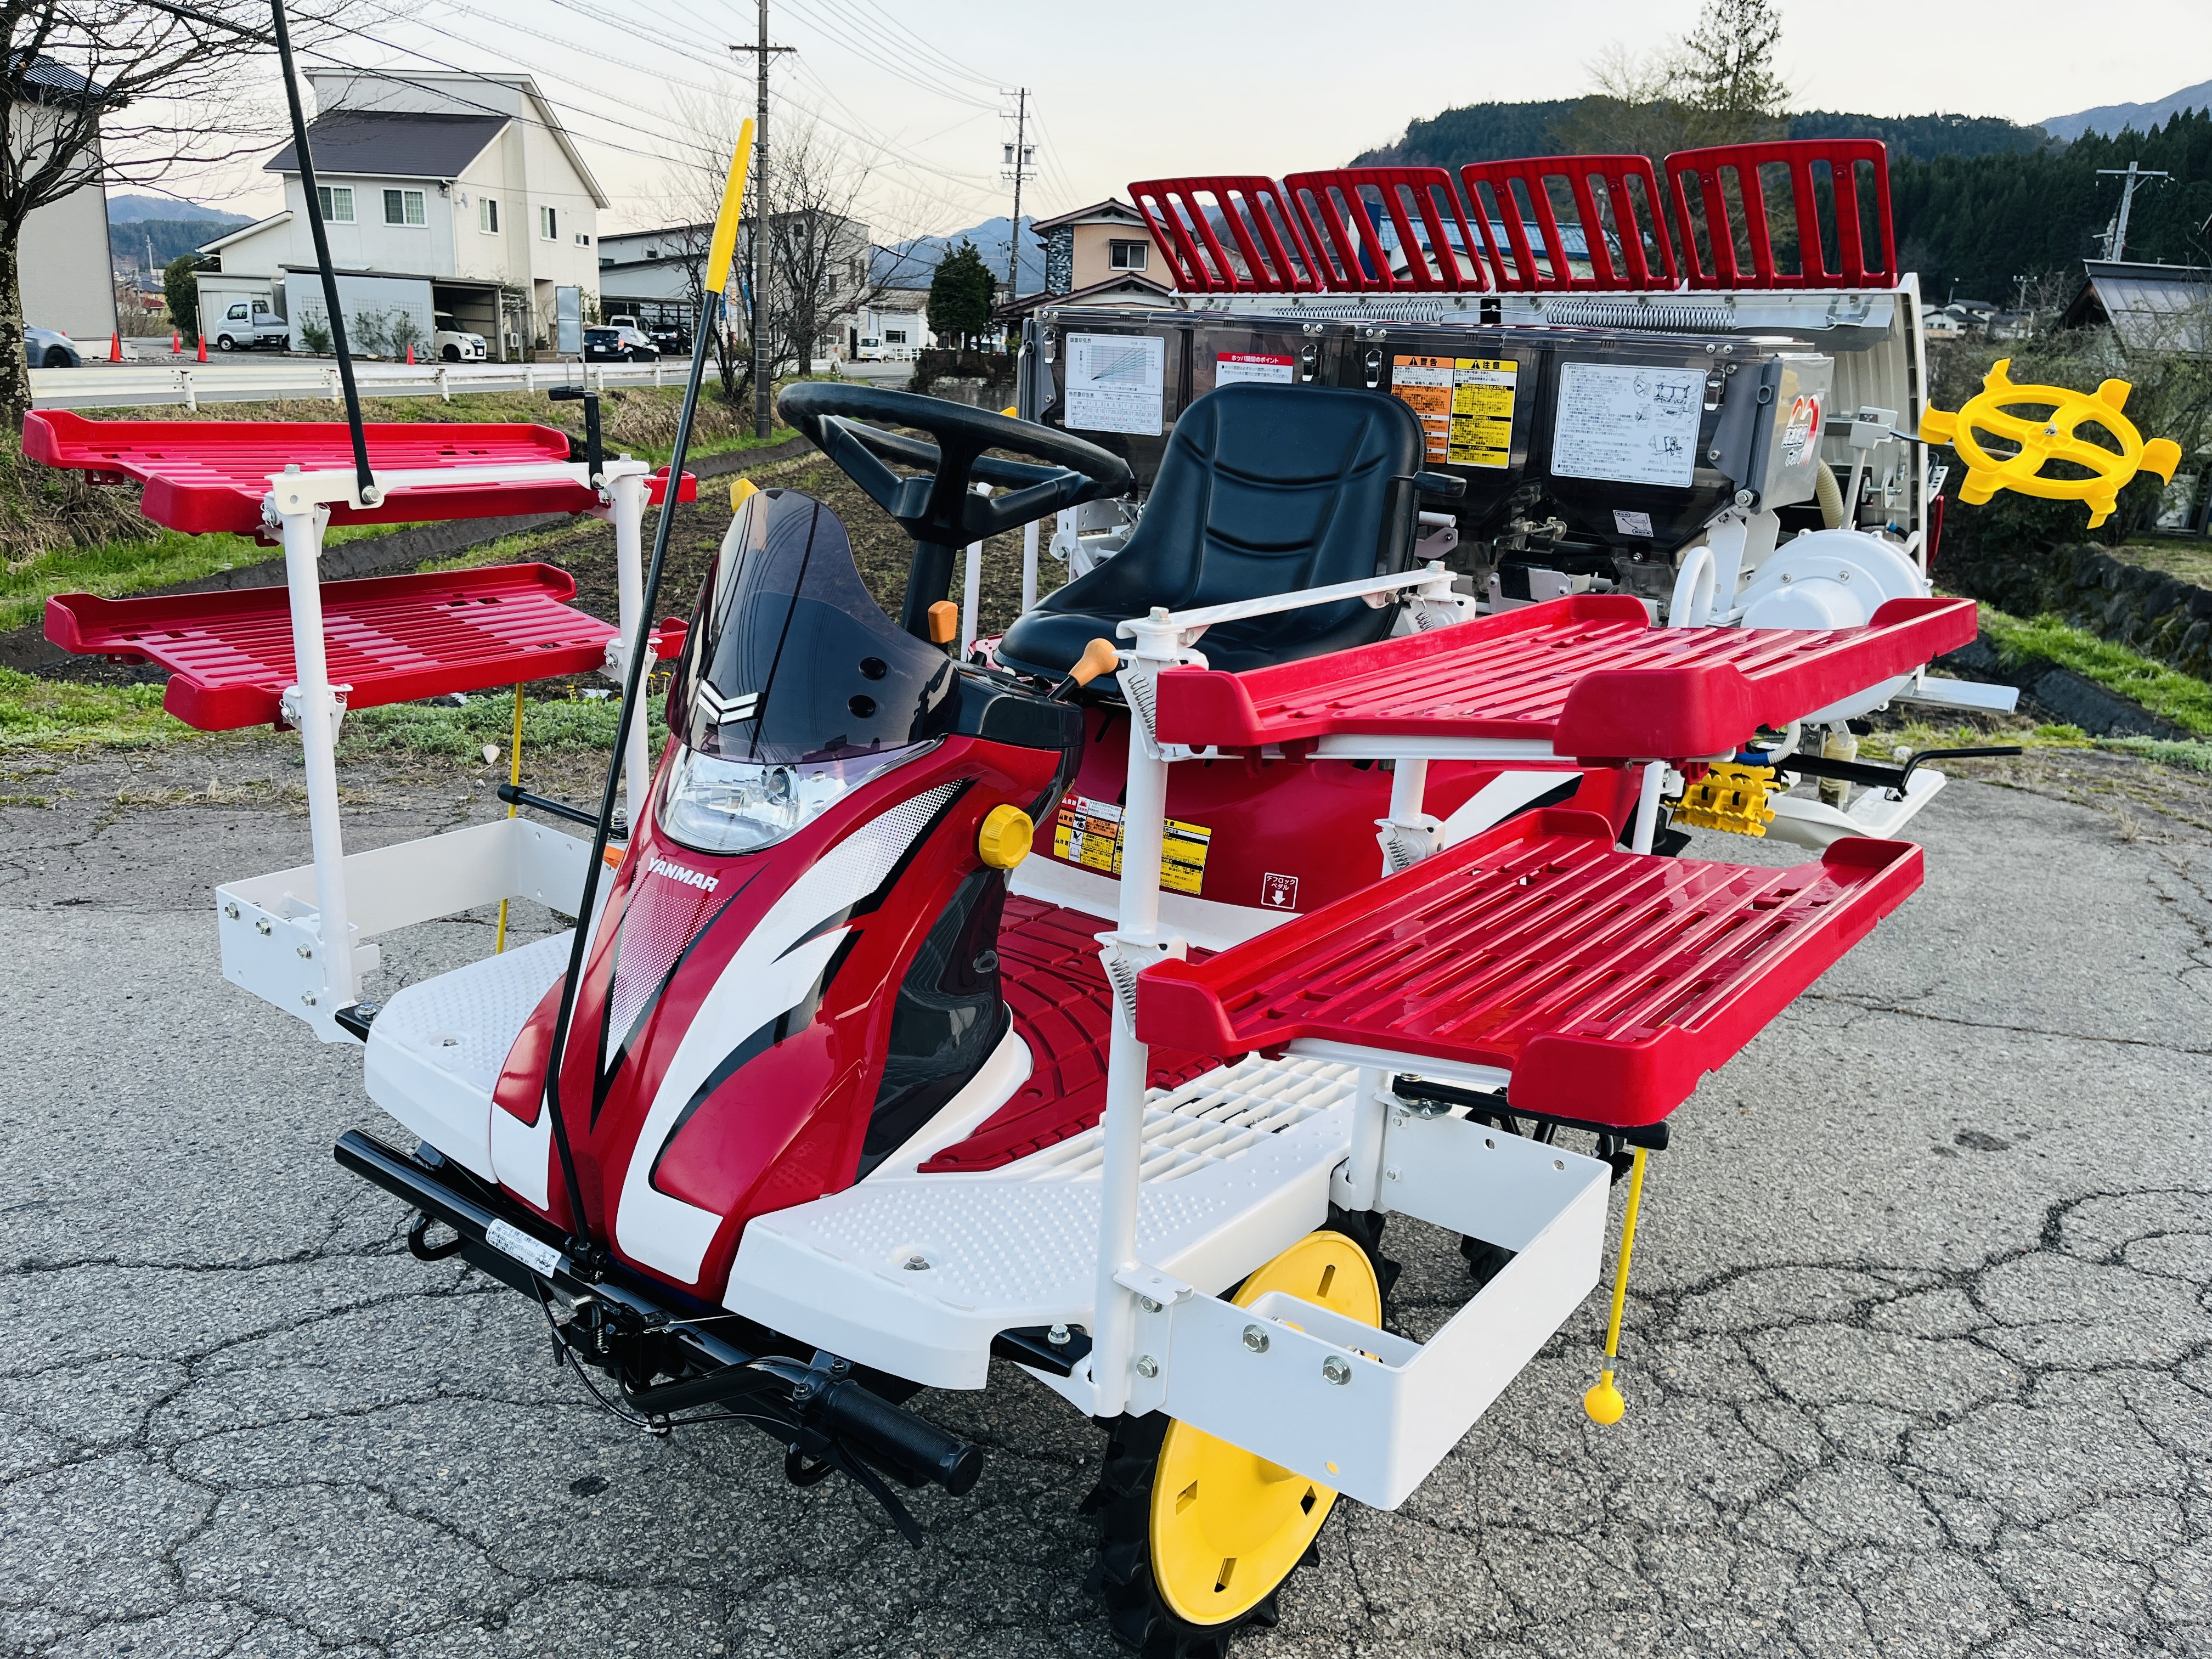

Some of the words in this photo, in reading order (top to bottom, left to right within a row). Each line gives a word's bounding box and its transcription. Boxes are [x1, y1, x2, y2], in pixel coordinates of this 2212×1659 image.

[1420, 358, 1437, 366] 警告
[1483, 361, 1500, 369] 注意
[647, 857, 719, 893] YANMAR
[1266, 875, 1295, 885] デフロック
